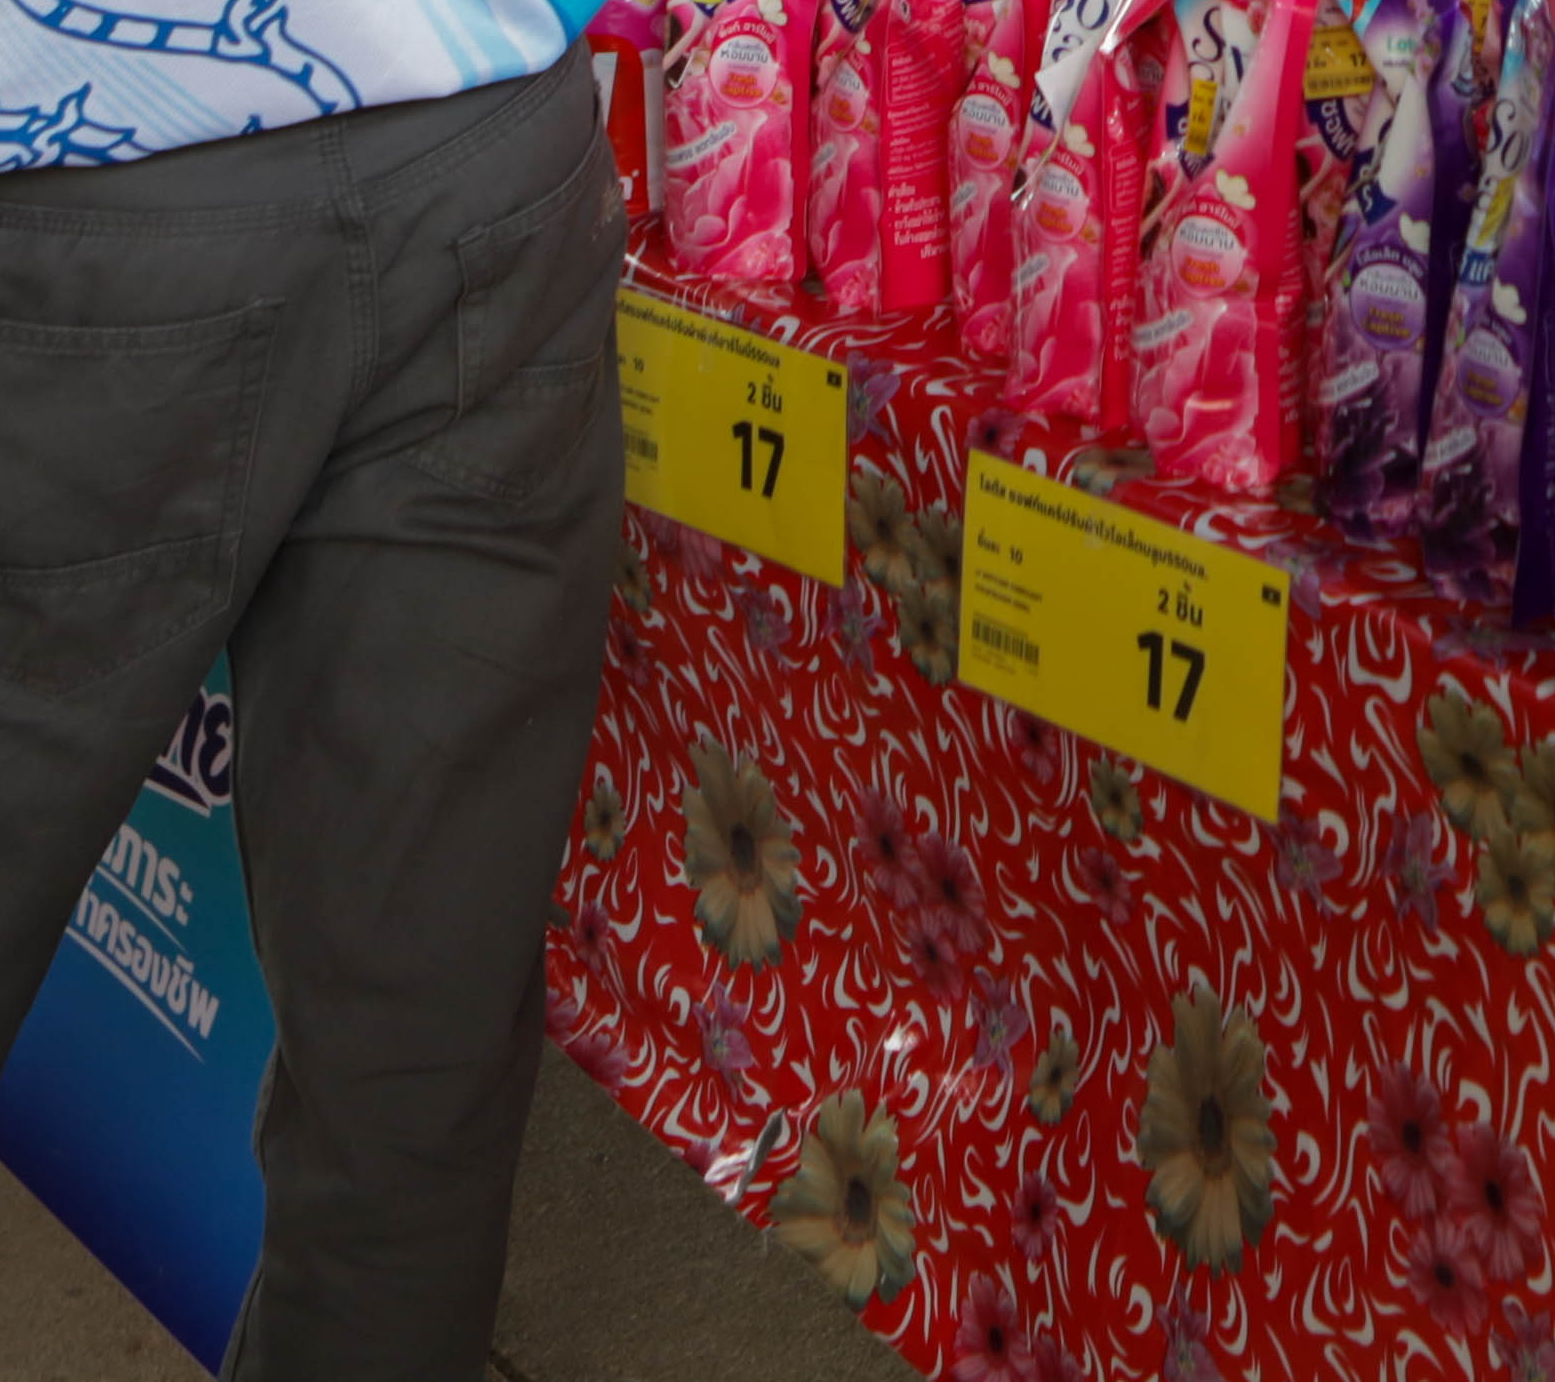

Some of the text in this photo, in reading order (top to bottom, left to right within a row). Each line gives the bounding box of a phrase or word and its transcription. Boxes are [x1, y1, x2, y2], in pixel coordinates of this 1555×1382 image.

[746, 382, 757, 405] 2
[730, 419, 785, 500] 17
[1157, 587, 1170, 615] 2
[1136, 629, 1205, 723] 17
